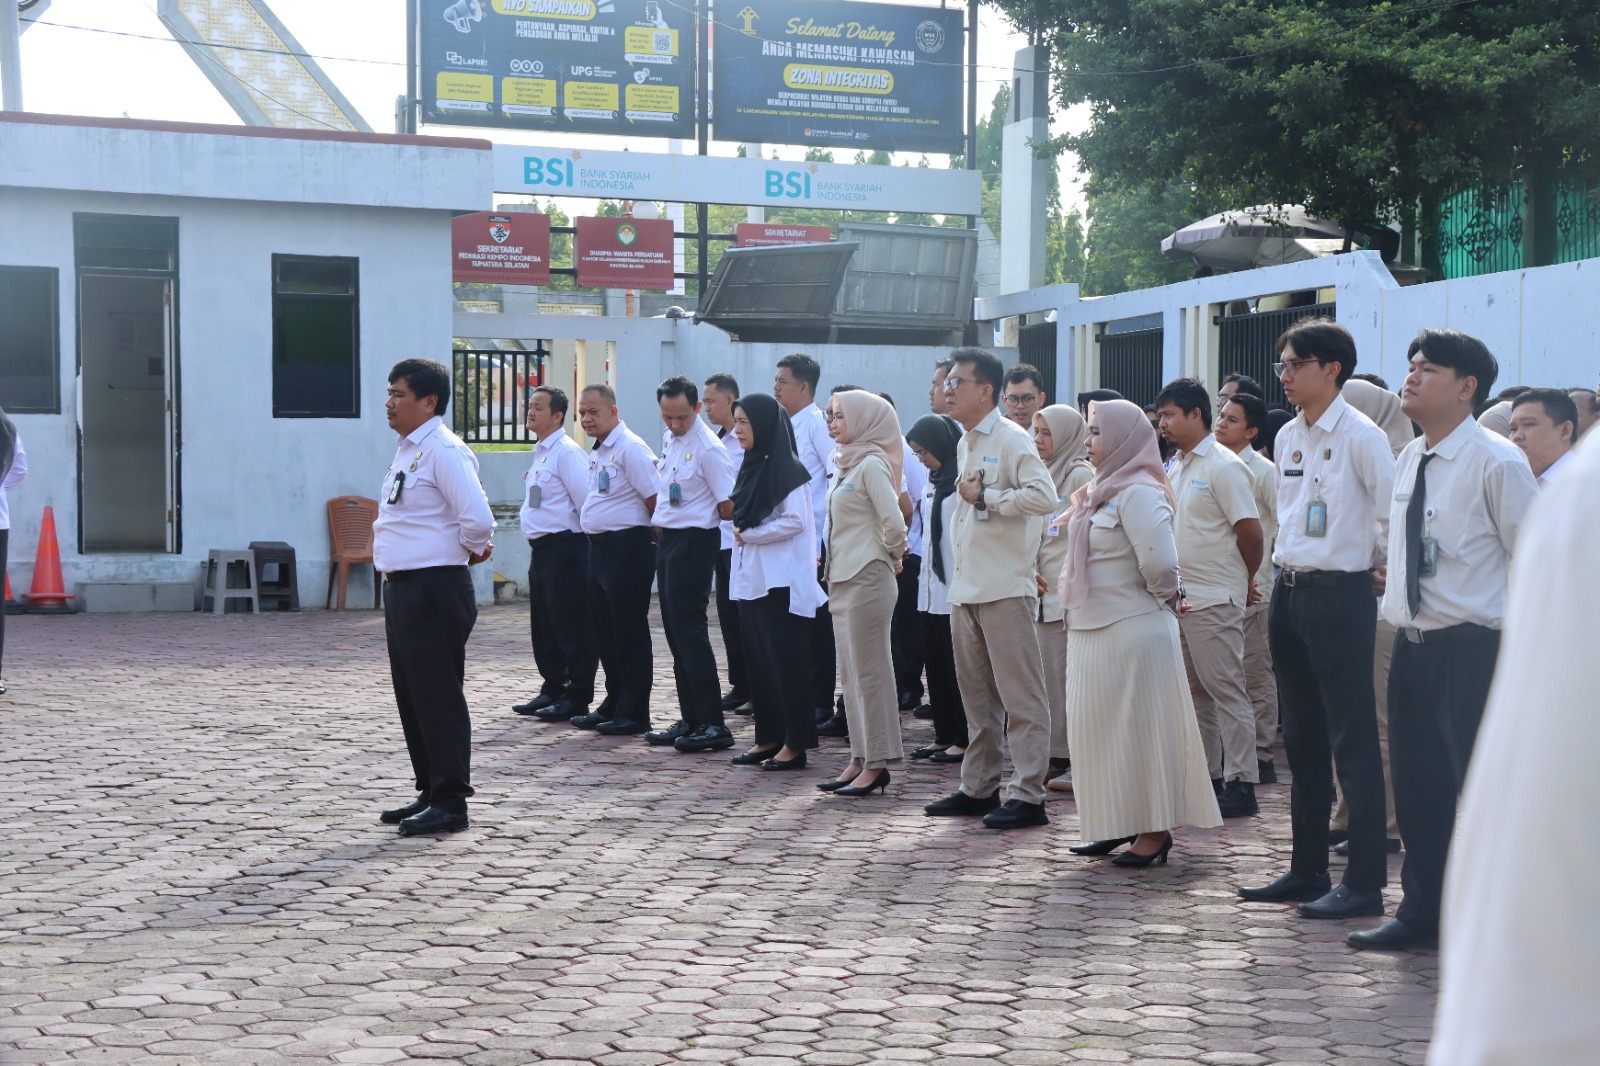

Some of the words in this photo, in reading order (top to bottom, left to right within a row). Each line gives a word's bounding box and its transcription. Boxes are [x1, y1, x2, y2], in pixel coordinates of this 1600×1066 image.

[503, 0, 526, 12] AYO
[529, 0, 591, 16] SAMPAIKAN
[516, 29, 552, 39] PENGADUAN
[553, 31, 570, 41] ANDA
[572, 32, 598, 43] MELALUI
[590, 26, 610, 35] KRITIK
[785, 17, 845, 38] Selamat
[845, 22, 895, 47] Datang
[762, 40, 792, 57] ANDA
[796, 43, 857, 62] MEMASUKI
[861, 47, 915, 66] KAWASAN
[462, 58, 488, 67] LAPOR!
[571, 65, 593, 77] UPG
[790, 68, 822, 85] ZONA
[825, 71, 889, 89] INTEGRITAS
[811, 93, 832, 102] WILAYAH
[833, 95, 848, 103] BEBAS
[850, 96, 861, 104] DARI
[861, 97, 881, 105] KORUPSI
[767, 98, 788, 106] MENUJU
[788, 99, 810, 108] WILAYAH
[837, 103, 854, 111] BERSIH
[854, 103, 865, 111] DAN
[865, 105, 890, 113] MELAYANI
[523, 156, 574, 187] BSI
[580, 168, 608, 179] BANK
[609, 170, 650, 181] SYARIAH
[580, 179, 635, 190] INDONESIA
[765, 170, 811, 199] BSI
[817, 181, 843, 191] BANK
[844, 183, 882, 193] SYARIAH
[817, 191, 868, 202] INDONESIA
[764, 228, 806, 237] SEKRETARIAT
[477, 245, 524, 254] SEKRETARIAT
[458, 252, 486, 260] FEDERASI
[472, 260, 503, 268] SUMATERA
